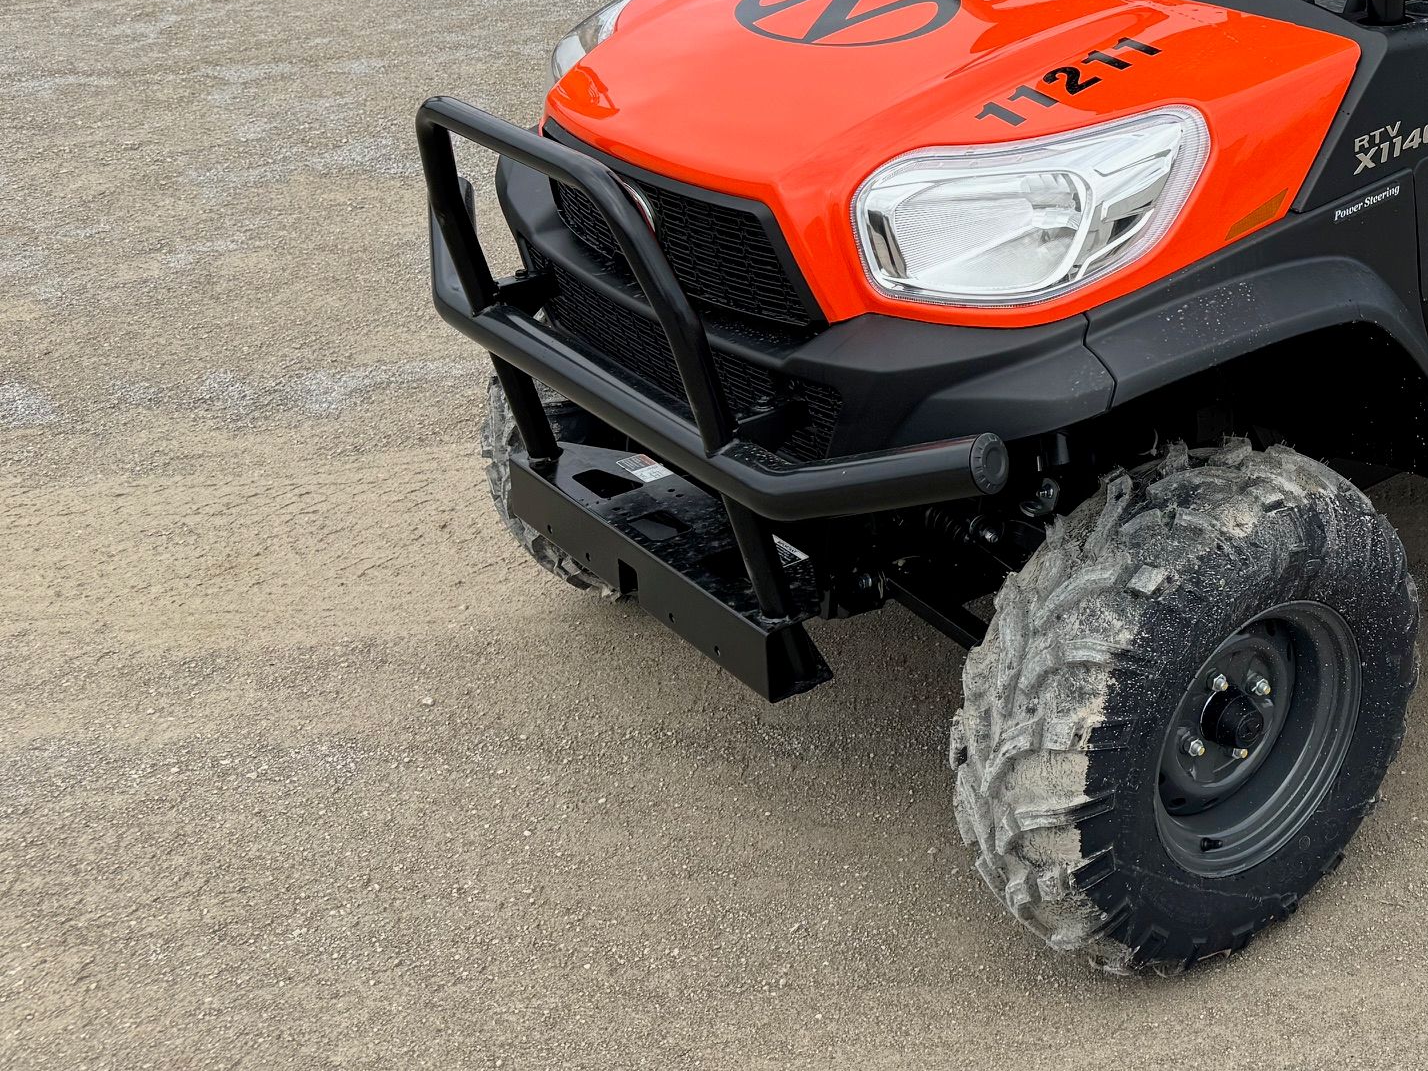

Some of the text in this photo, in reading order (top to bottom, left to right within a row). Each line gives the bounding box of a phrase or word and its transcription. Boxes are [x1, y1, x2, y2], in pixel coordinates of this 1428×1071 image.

[974, 36, 1163, 127] 11211
[1354, 120, 1402, 153] RTV
[1334, 185, 1401, 222] Power Steering
